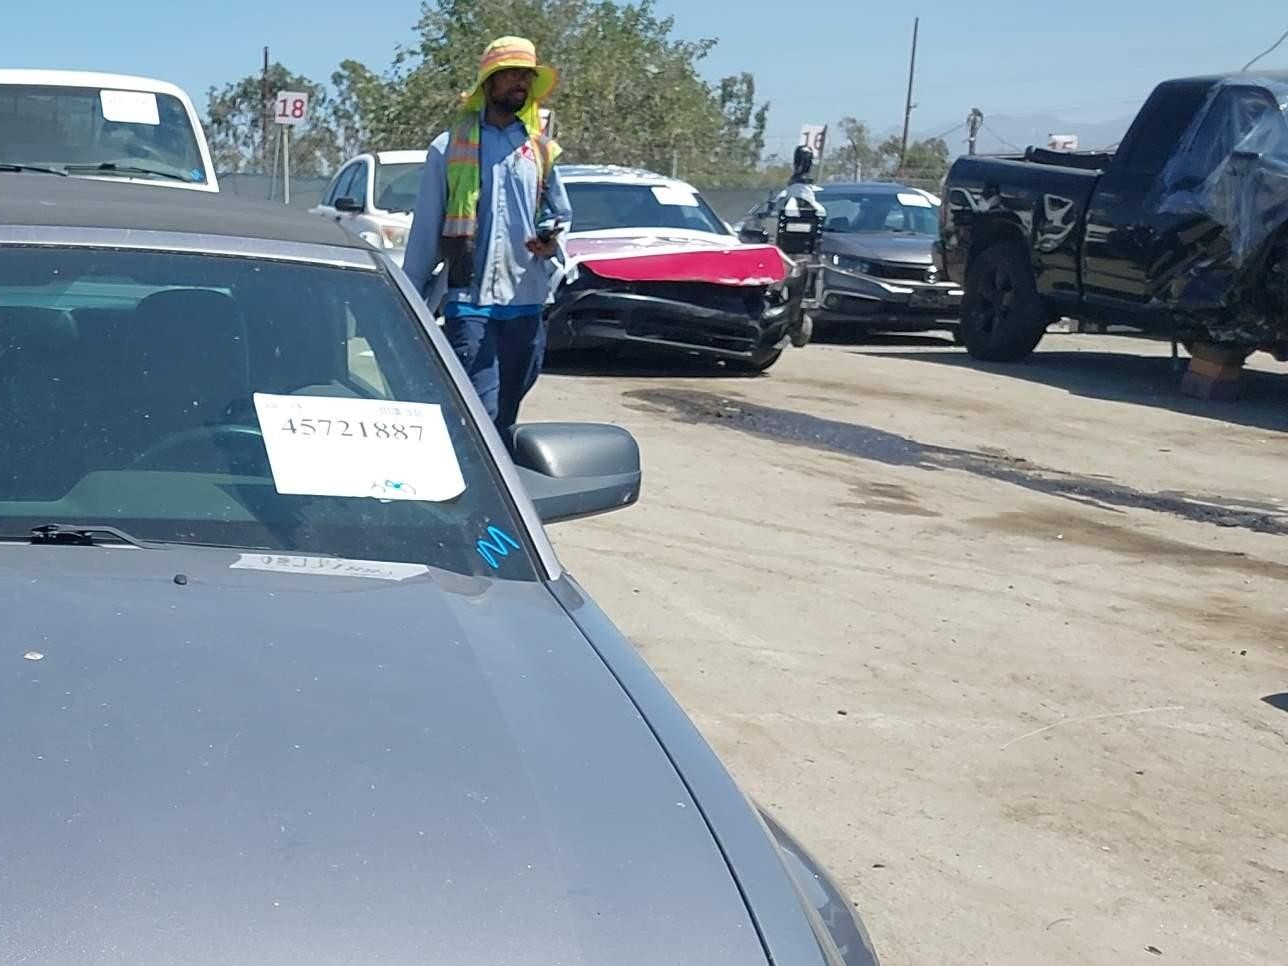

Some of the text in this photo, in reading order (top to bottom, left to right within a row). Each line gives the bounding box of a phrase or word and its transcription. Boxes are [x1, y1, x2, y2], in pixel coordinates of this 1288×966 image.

[278, 98, 304, 118] 18
[282, 417, 424, 441] 45721887
[477, 526, 520, 568] M
